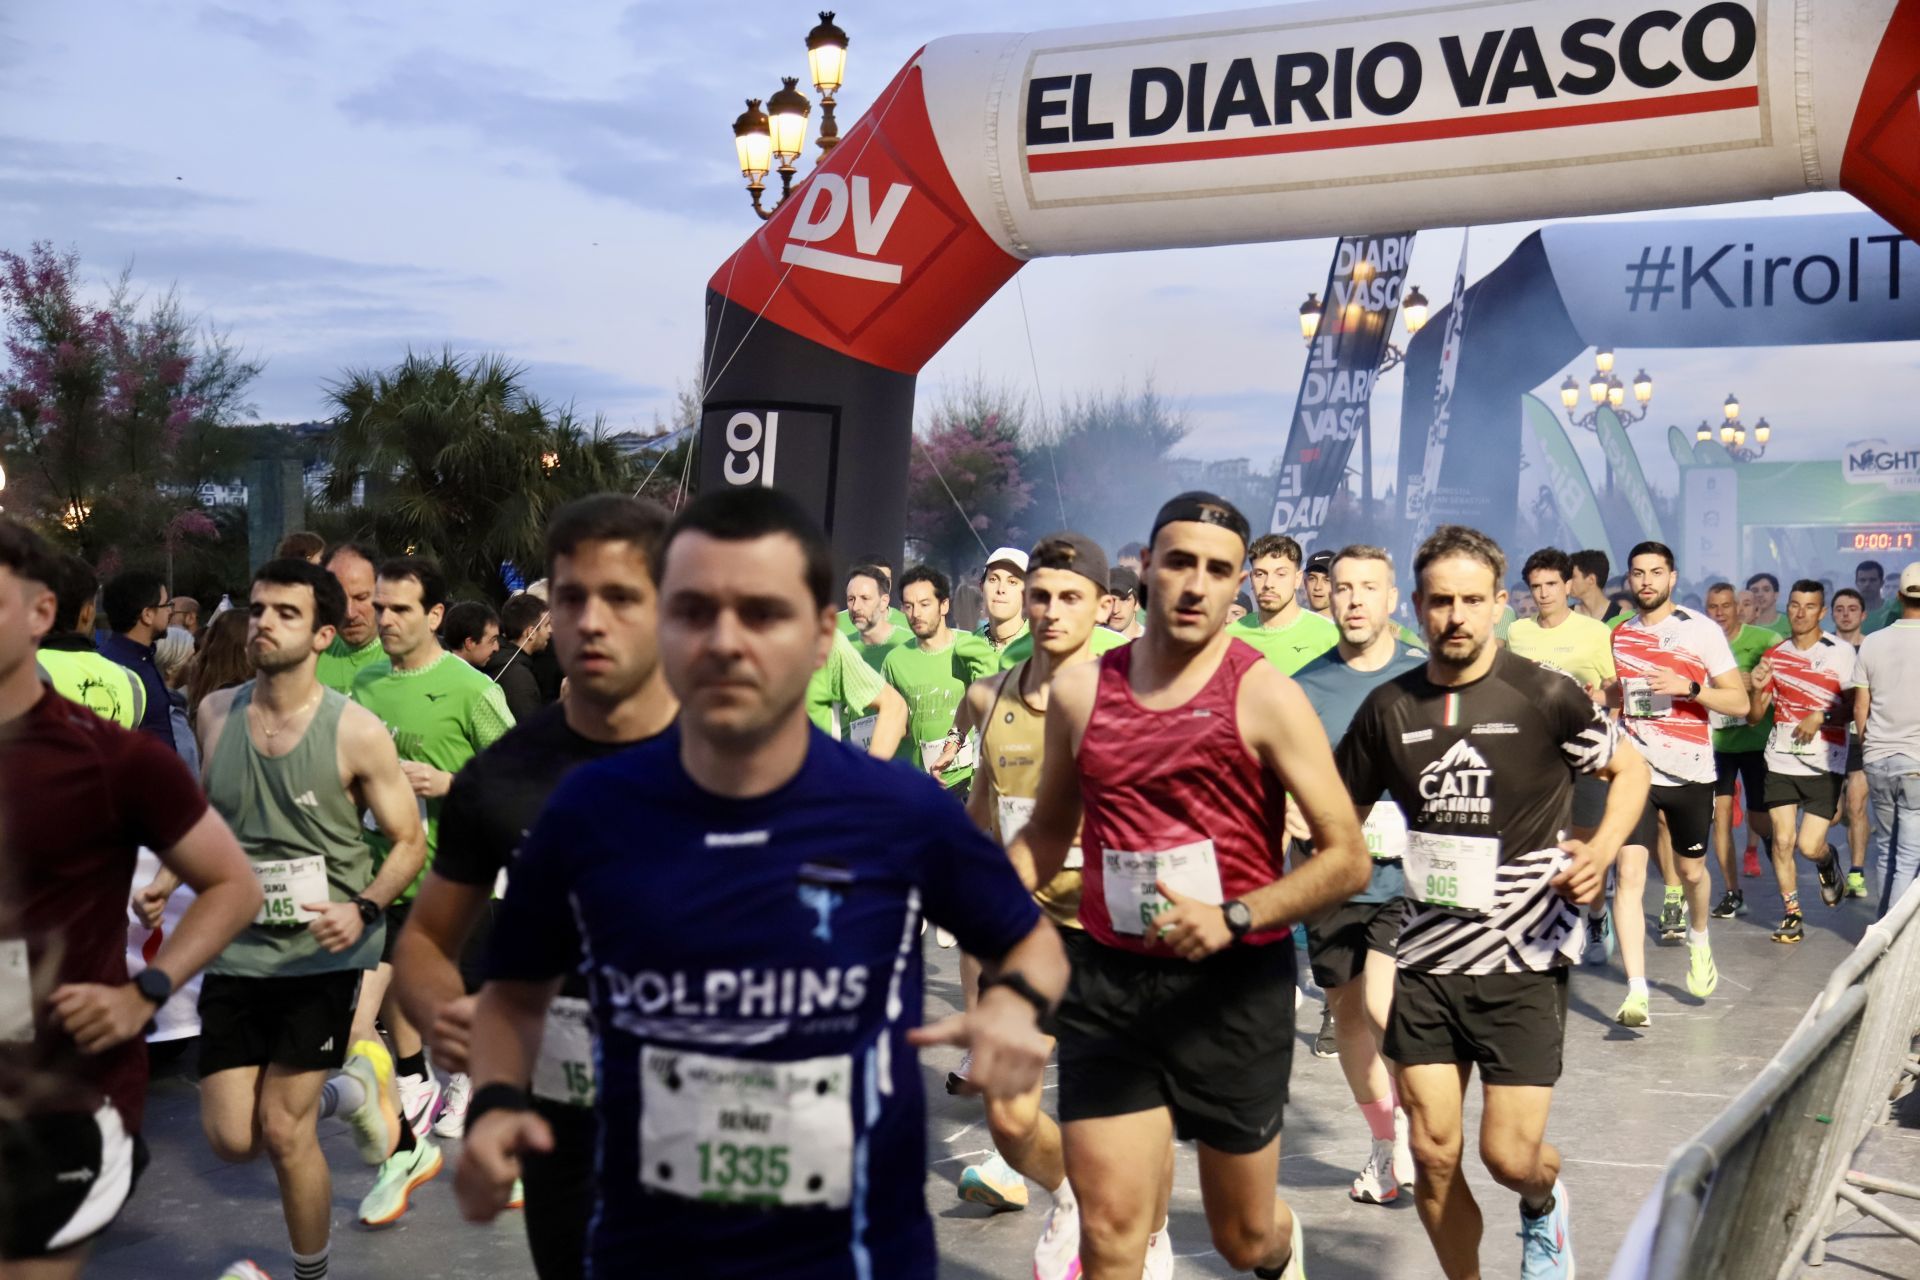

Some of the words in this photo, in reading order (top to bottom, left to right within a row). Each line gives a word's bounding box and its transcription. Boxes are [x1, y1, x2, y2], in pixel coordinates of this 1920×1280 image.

[1026, 75, 1115, 146] EL
[1128, 41, 1424, 140] DIARIO
[1438, 1, 1757, 107] VASCO
[788, 173, 912, 256] DV
[1332, 276, 1406, 312] VASC
[1855, 533, 1912, 549] 0:00:17
[1418, 769, 1492, 800] CATT
[1425, 873, 1458, 899] 905
[264, 896, 295, 918] 145
[601, 964, 869, 1017] DOLPHINS
[697, 1142, 790, 1189] 1335
